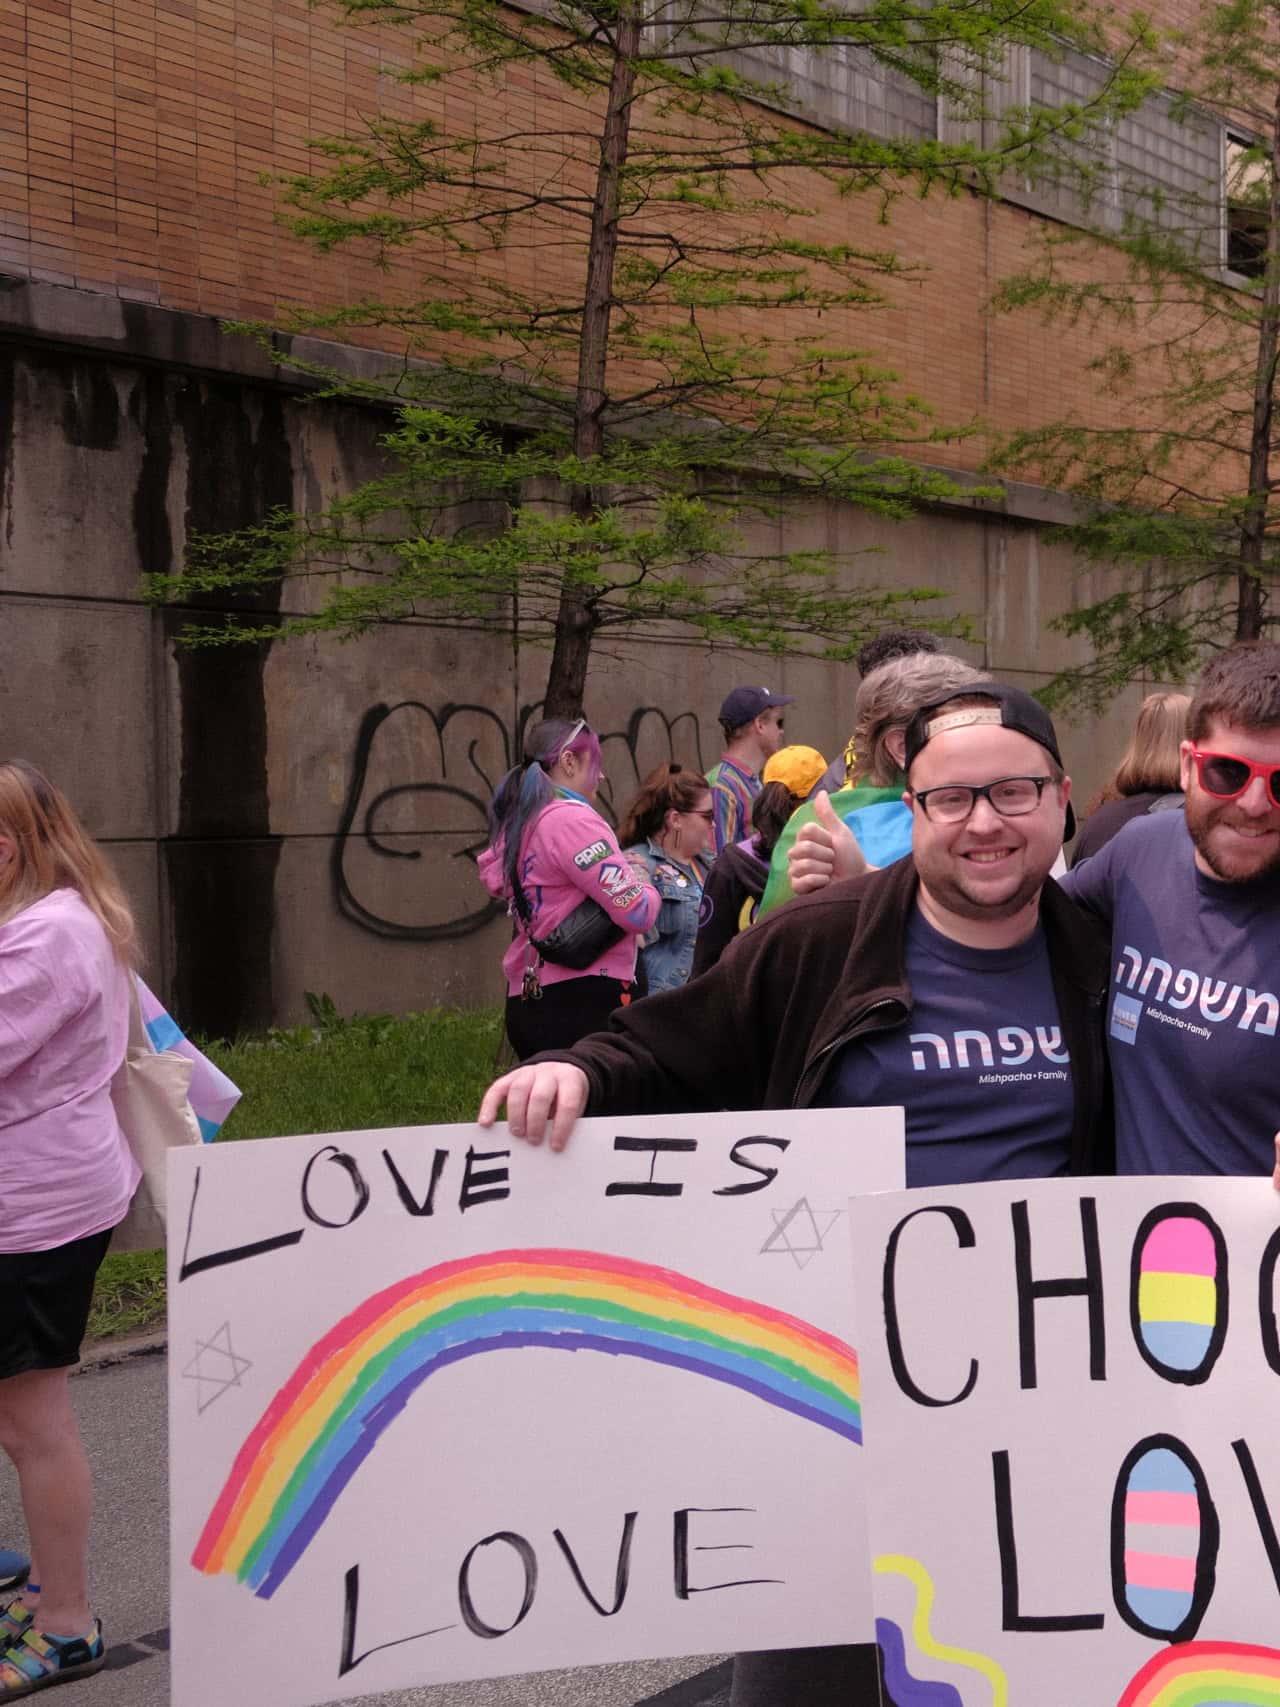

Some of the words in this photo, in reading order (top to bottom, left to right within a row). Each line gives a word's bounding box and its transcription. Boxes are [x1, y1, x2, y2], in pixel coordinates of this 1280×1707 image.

[908, 1026, 1071, 1071] שפחה
[1114, 945, 1280, 1037] משפחה
[179, 1144, 512, 1283] LOVE
[604, 1135, 792, 1197] IS
[337, 1507, 786, 1679] LOVE
